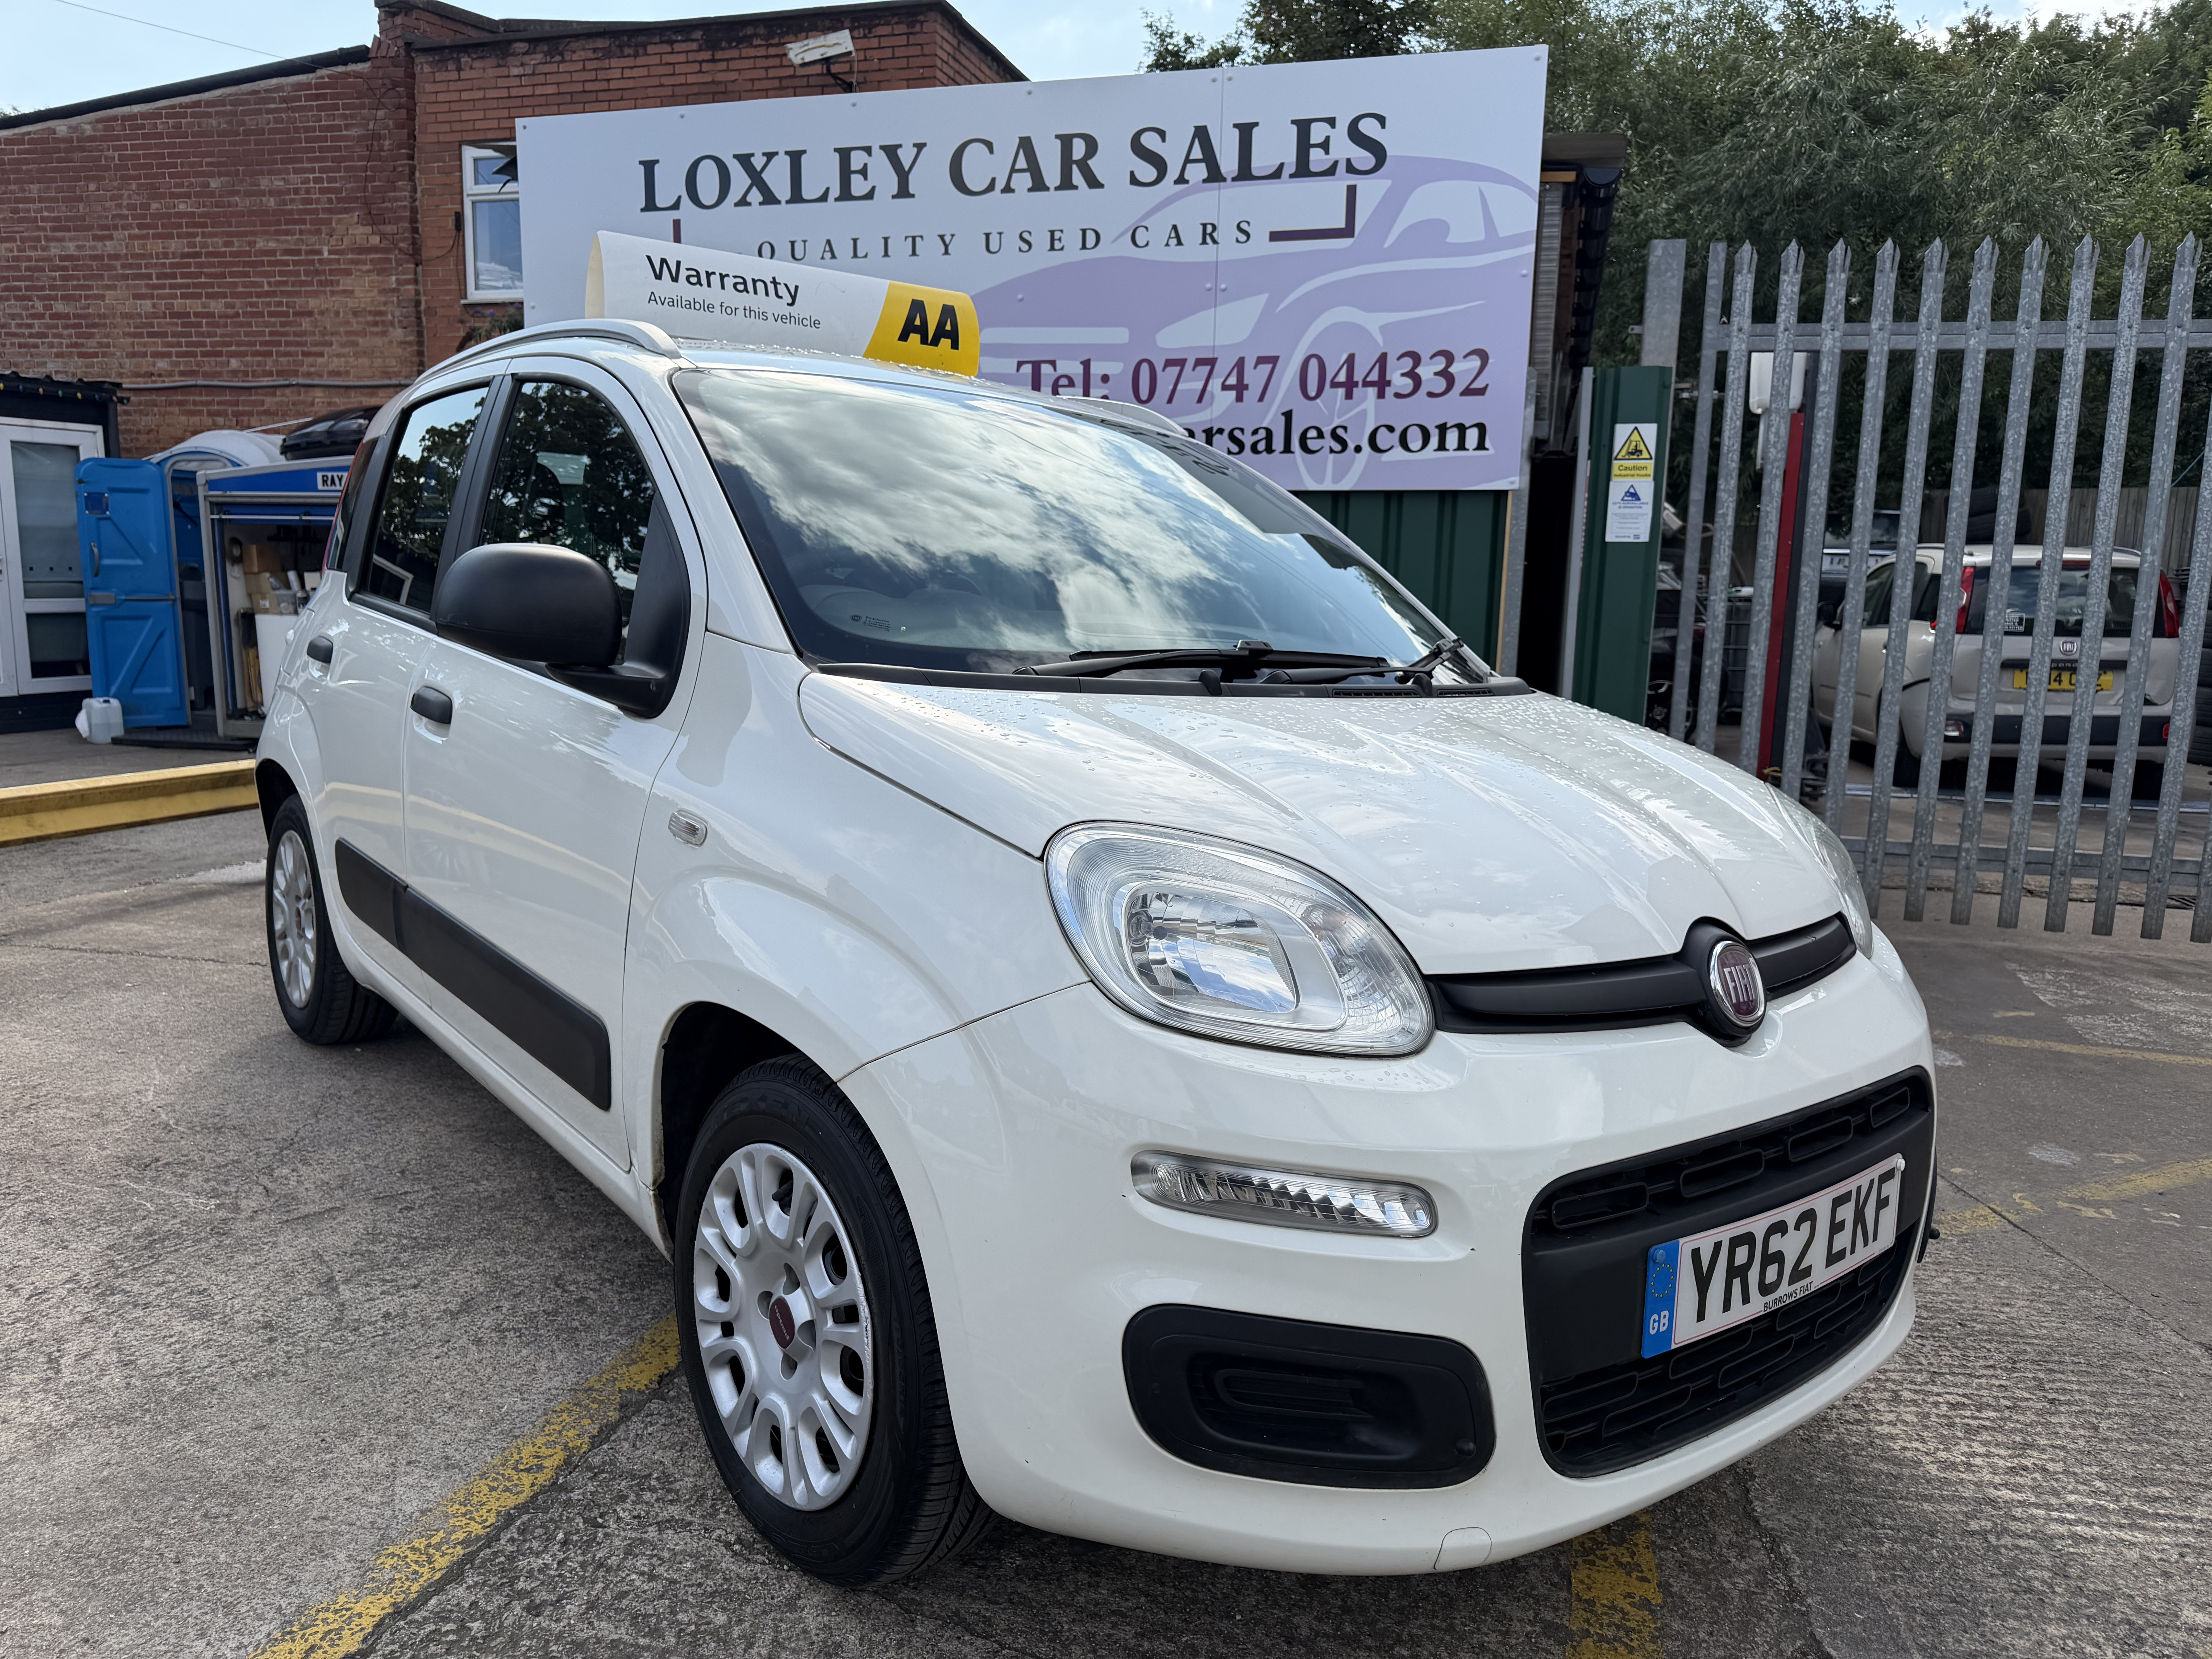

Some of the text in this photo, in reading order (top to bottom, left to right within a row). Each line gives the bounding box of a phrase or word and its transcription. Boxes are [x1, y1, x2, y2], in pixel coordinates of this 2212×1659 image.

[638, 112, 1388, 212] LOXLEY CAR SALES
[757, 220, 1251, 261] QUALITY USED CARS
[646, 254, 800, 307] Warranty
[648, 291, 821, 330] Available for this vehicle
[897, 299, 959, 350] AA
[1016, 348, 1491, 406] Tel: 07747 044332
[322, 474, 343, 488] RAY
[1723, 964, 1756, 1004] FIAT
[1691, 1167, 1896, 1324] YR62 EKF
[1763, 1277, 1814, 1312] BURROWS FIAT
[1649, 1310, 1669, 1335] GB
